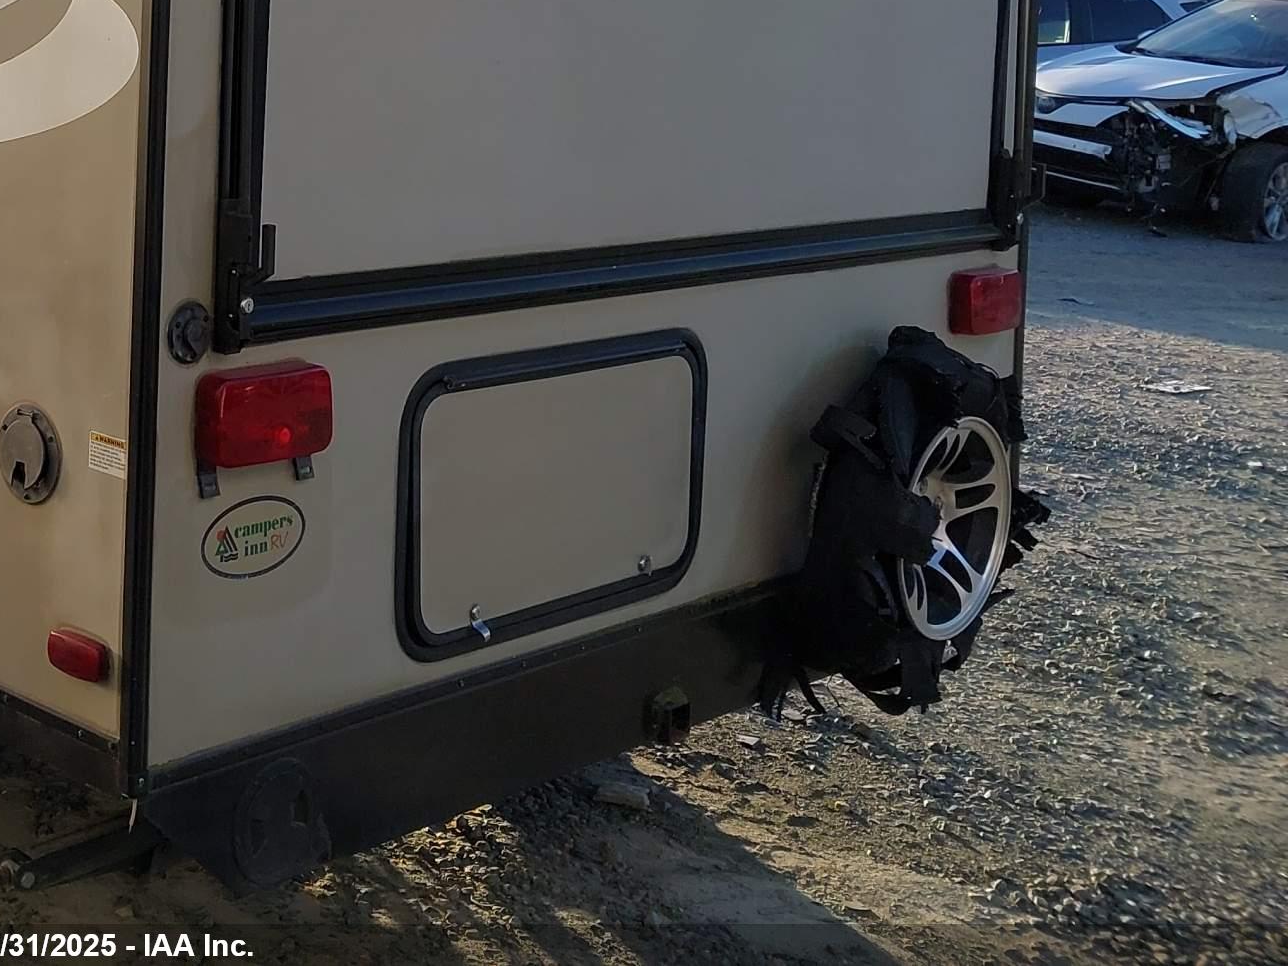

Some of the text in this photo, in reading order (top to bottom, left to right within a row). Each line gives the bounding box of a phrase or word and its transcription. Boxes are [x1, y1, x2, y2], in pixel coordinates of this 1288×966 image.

[234, 515, 294, 539] campers
[244, 530, 289, 556] inn RV
